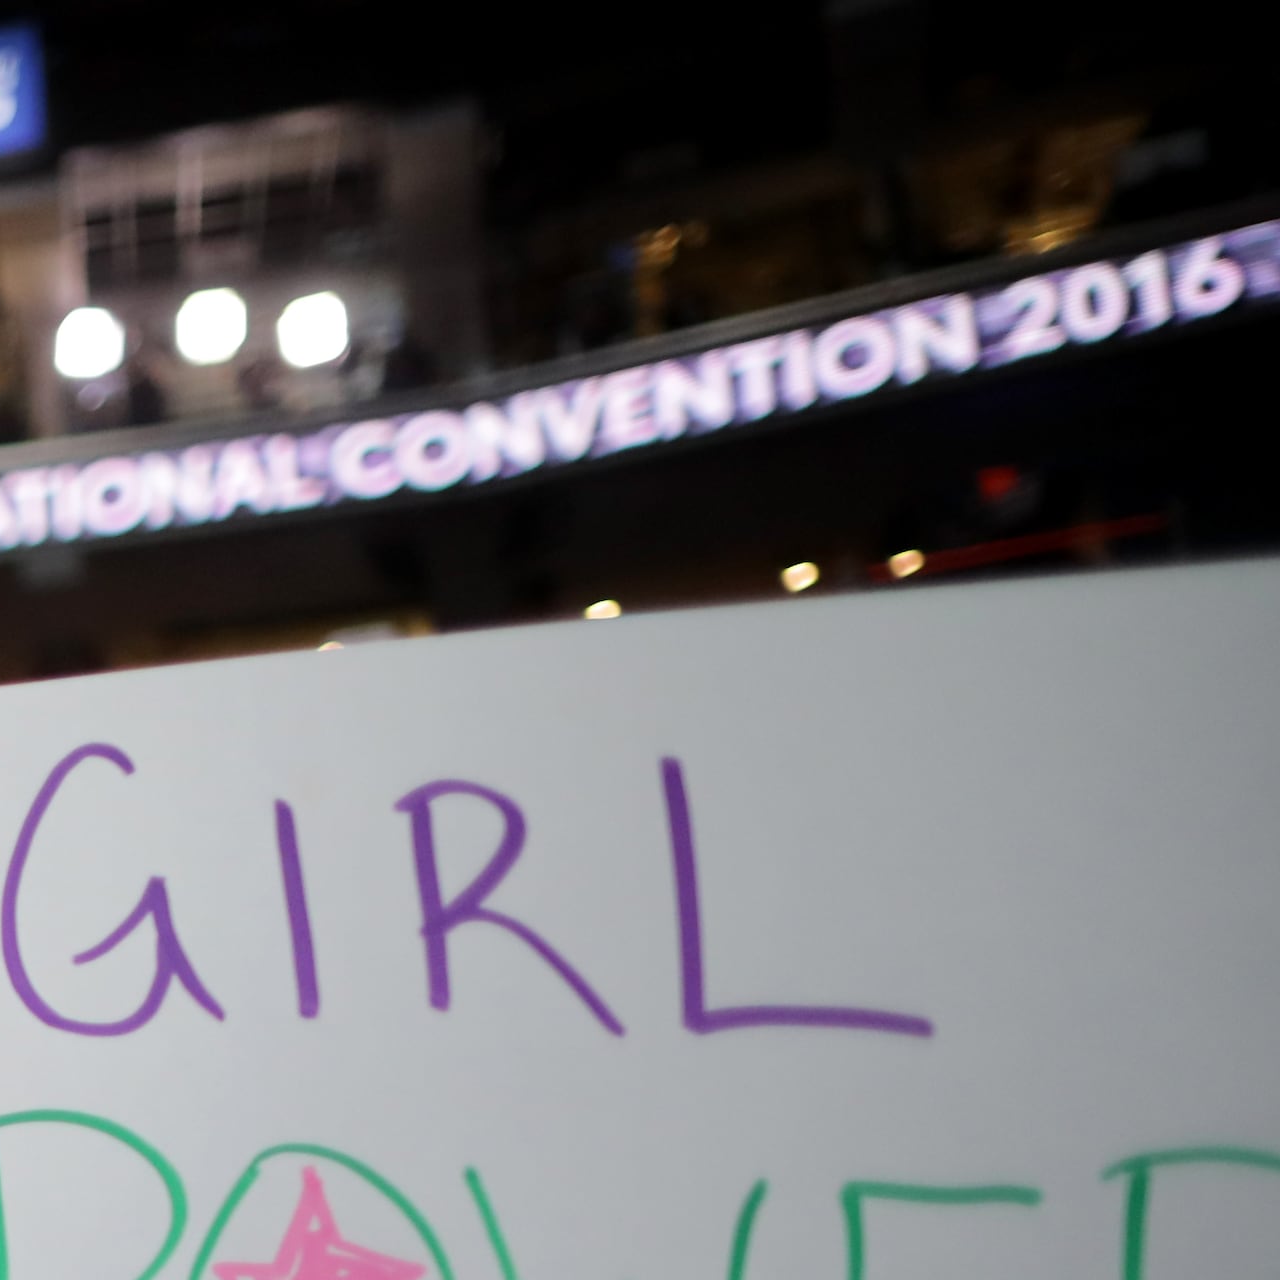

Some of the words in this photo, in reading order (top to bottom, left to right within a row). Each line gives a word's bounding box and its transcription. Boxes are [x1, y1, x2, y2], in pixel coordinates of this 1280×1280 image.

[328, 292, 981, 502] CONVENTION
[1000, 234, 1243, 359] 2016
[0, 742, 935, 1038] GIRL
